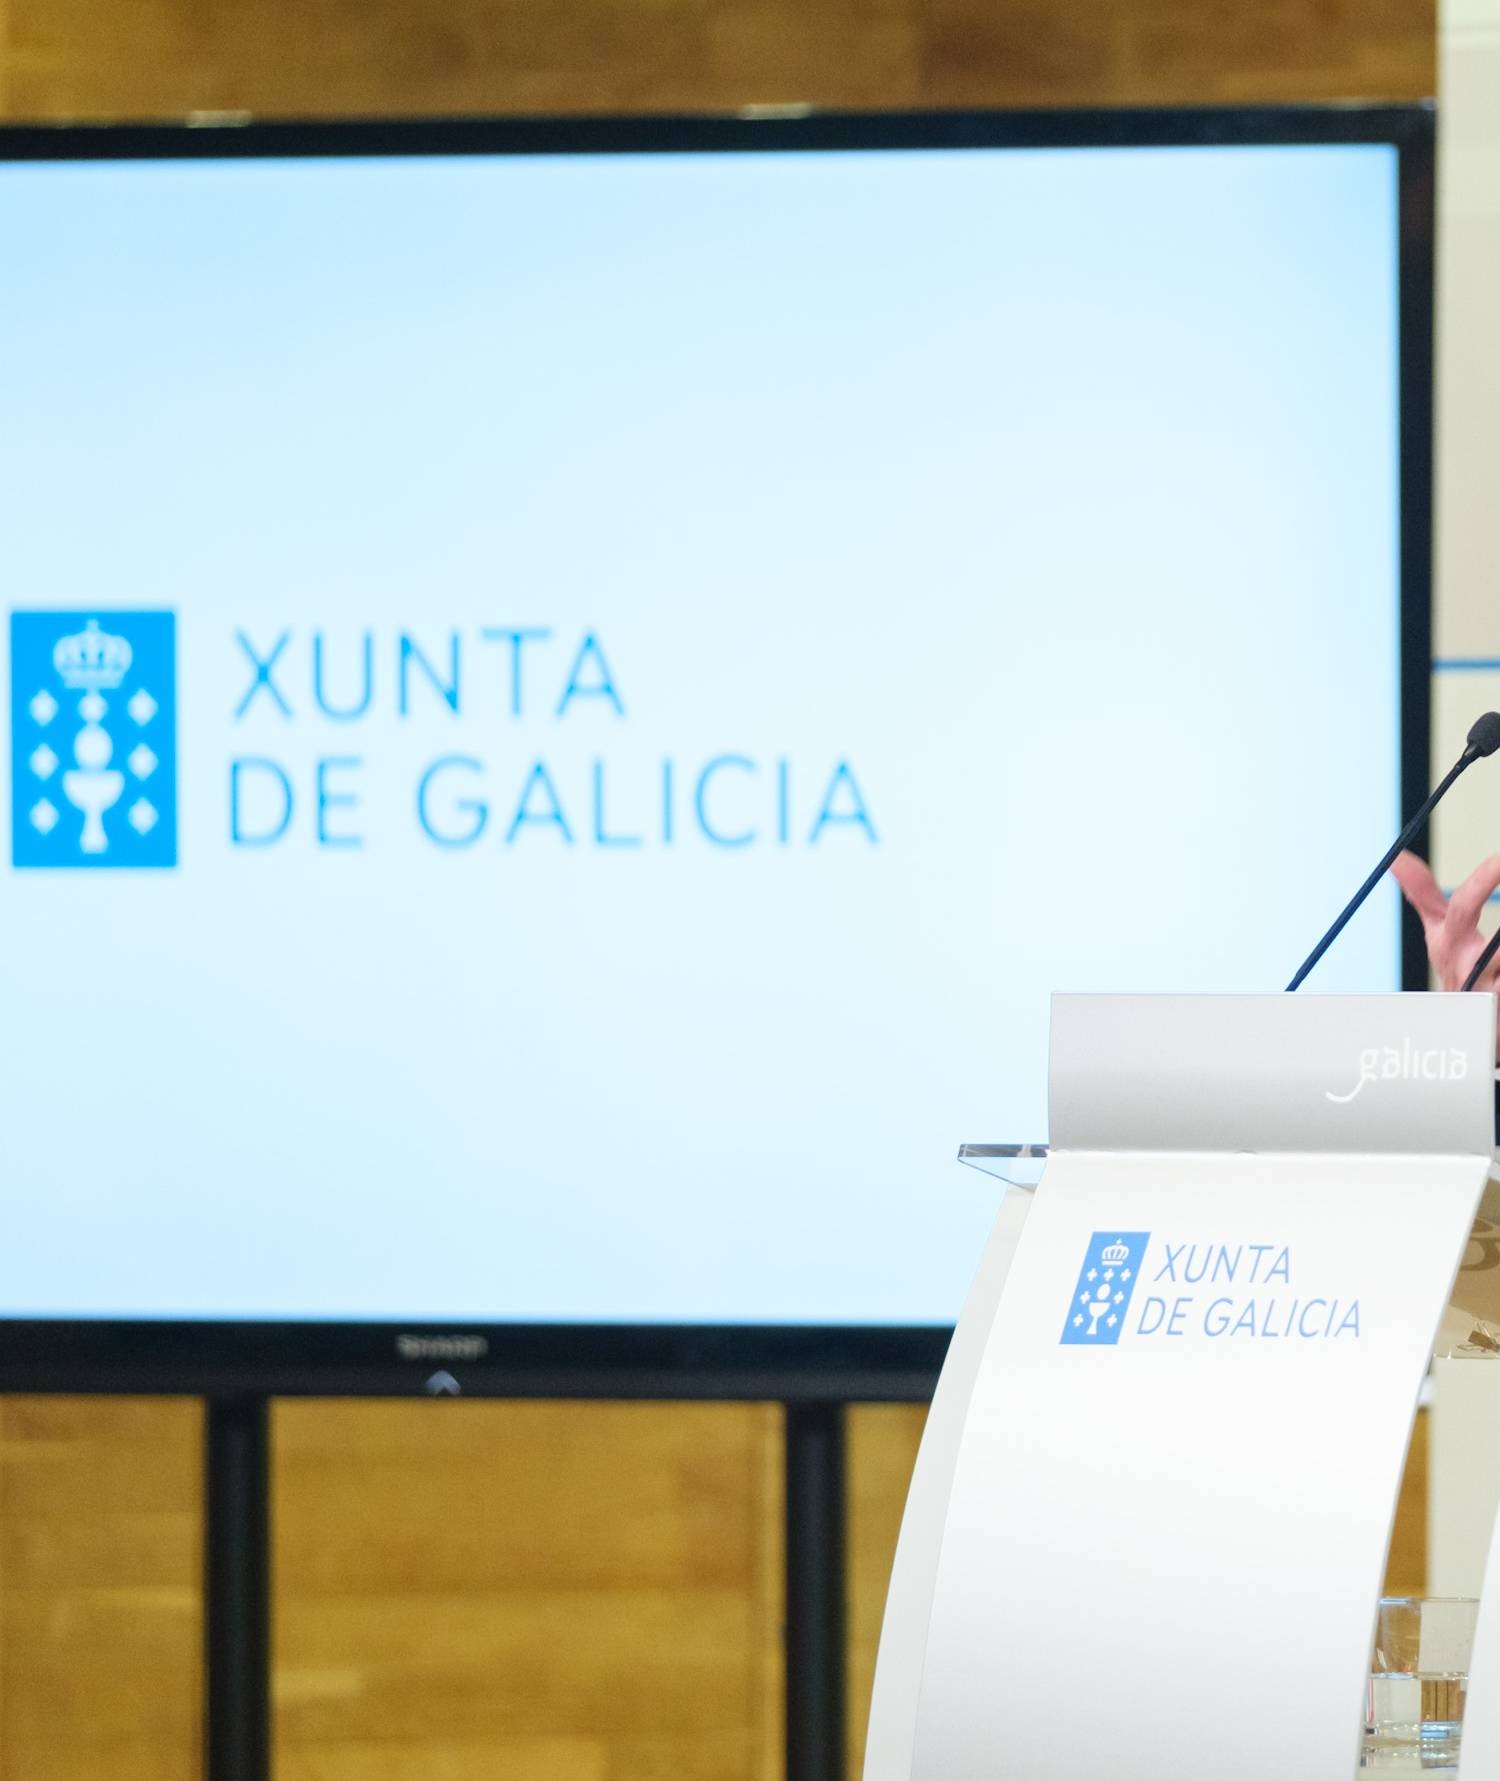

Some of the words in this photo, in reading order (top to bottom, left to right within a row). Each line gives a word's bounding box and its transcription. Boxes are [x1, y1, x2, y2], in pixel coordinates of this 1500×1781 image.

[232, 627, 627, 722] XUNTA
[228, 756, 364, 849] DE
[414, 753, 880, 851] GALICIA
[1325, 1036, 1468, 1103] galicia
[1153, 1243, 1291, 1284] XUNTA
[1136, 1296, 1193, 1336] DE
[1202, 1296, 1361, 1338] GALICIA
